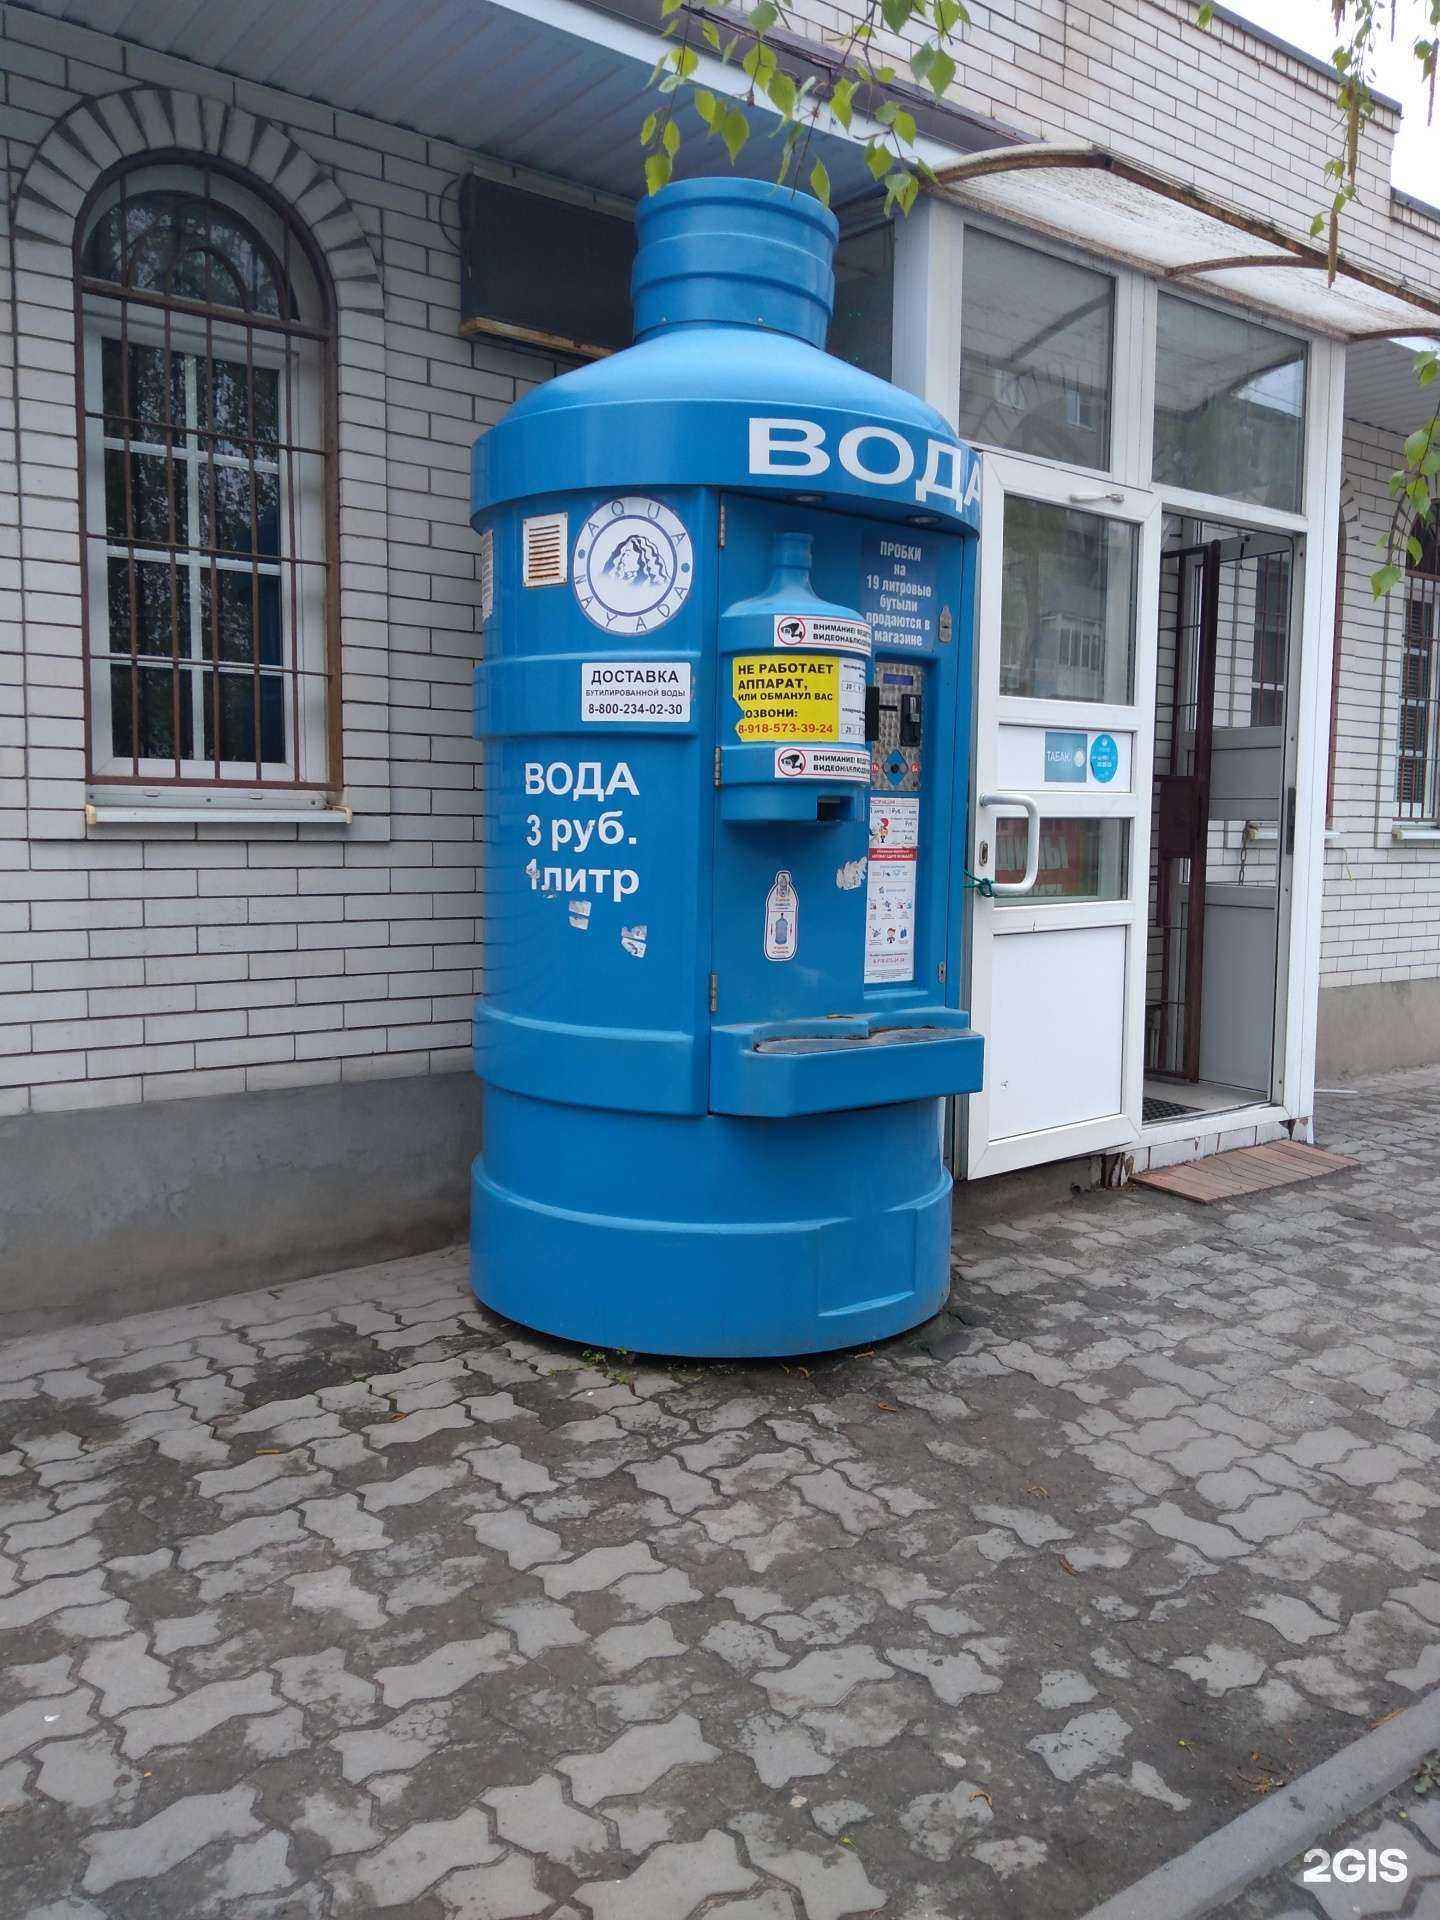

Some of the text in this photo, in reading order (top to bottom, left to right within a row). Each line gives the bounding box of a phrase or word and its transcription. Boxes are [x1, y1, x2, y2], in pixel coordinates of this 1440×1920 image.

[749, 418, 981, 513] ВОДА
[587, 500, 687, 547] AQUA
[880, 540, 921, 561] ПРОБКИ
[893, 563, 906, 576] на
[866, 574, 932, 597] 19 литровые
[575, 572, 689, 634] NAYADA
[880, 595, 918, 612] бутыли
[924, 621, 930, 630] в
[874, 630, 922, 646] магазине
[738, 665, 755, 675] НЕ
[759, 663, 833, 674] РАБОТАЕТ
[591, 670, 679, 685] ДОСТАВКА
[738, 679, 808, 691] АППАРАТ,
[738, 692, 832, 702] ИЛИ ОБМАНУЛ ВАС
[588, 703, 683, 715] 8-800-234-02-30
[744, 709, 798, 719] ОЗВОНИ:
[738, 724, 832, 734] 8-918-573-39-24
[525, 762, 640, 802] ВОДА
[526, 811, 637, 853] 3 руб.
